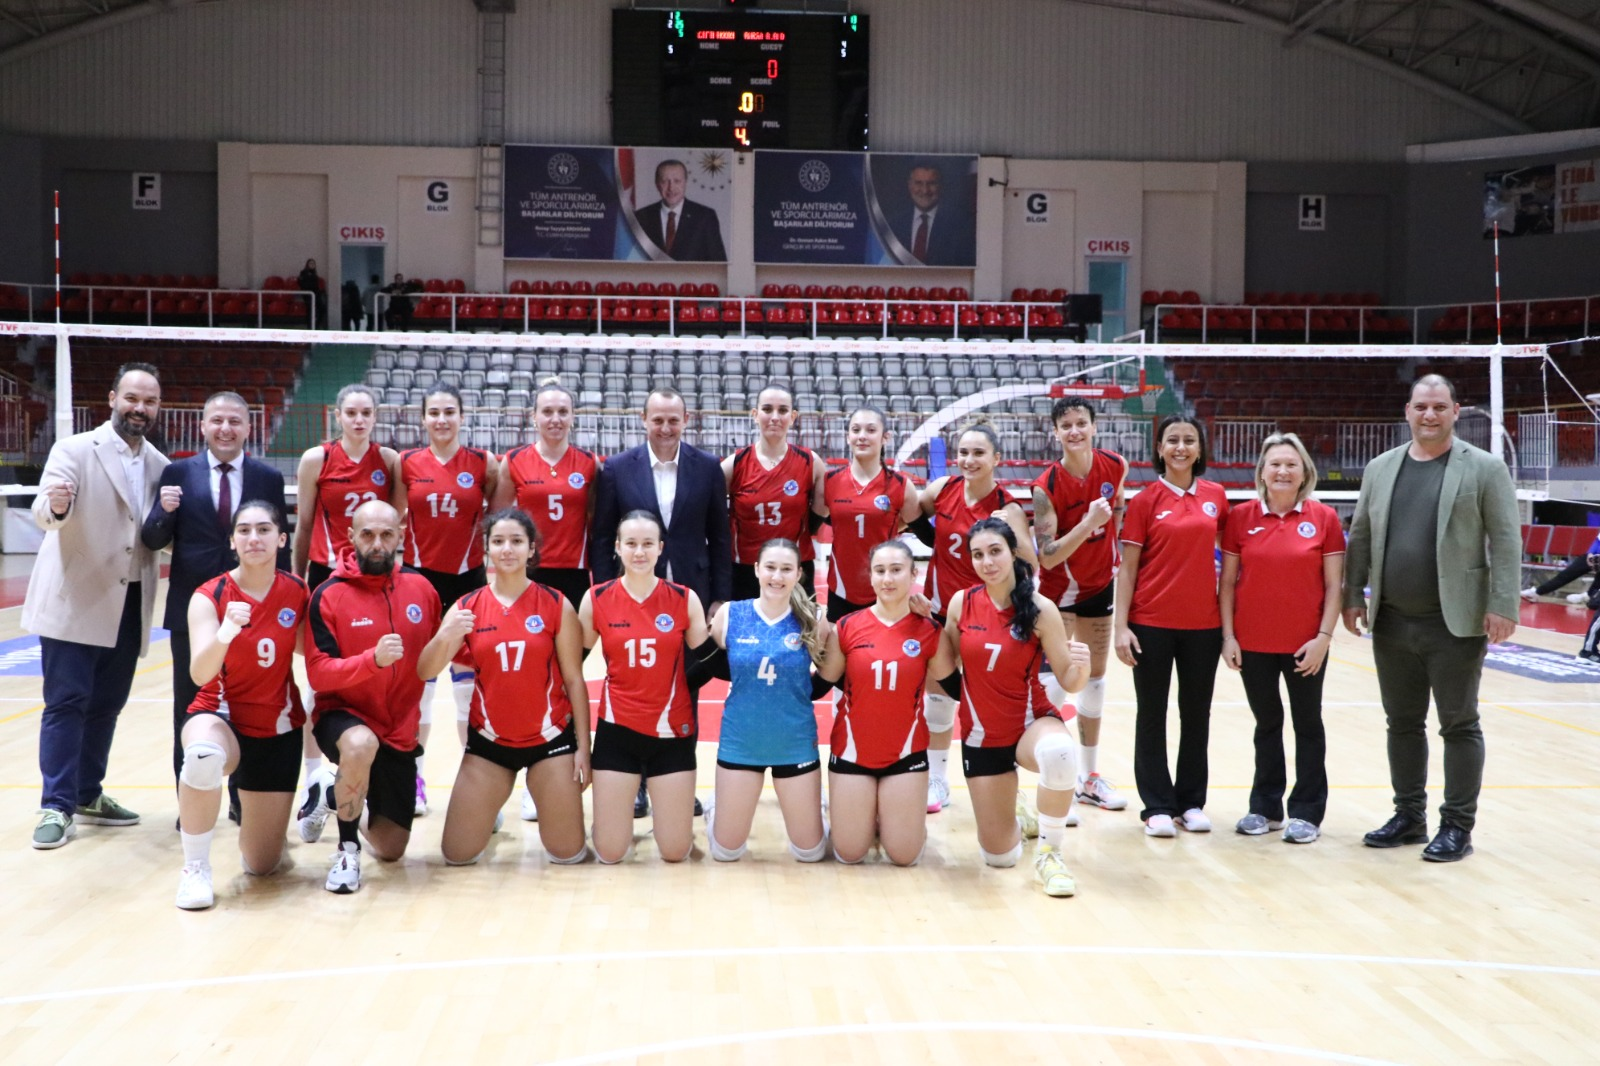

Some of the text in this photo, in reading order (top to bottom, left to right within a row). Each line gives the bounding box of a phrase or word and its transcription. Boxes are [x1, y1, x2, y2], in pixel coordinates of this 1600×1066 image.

[768, 60, 778, 78] 0
[139, 176, 154, 197] F
[427, 181, 449, 202] G
[530, 191, 597, 202] TÜM ANTRENÖR
[532, 201, 606, 210] SPORCULARIMIZA
[780, 201, 848, 211] TÜM ANTRENÖR
[1027, 193, 1047, 214] G
[1303, 198, 1321, 218] H
[522, 210, 562, 219] BAŞARILAR
[774, 220, 813, 229] BAŞARILAR
[784, 210, 857, 220] SPORCULARIMIZA
[340, 226, 385, 242] ÇIKIŞ
[1088, 240, 1130, 254] ÇIKIŞ
[426, 493, 458, 518] 14
[548, 494, 564, 520] 5
[755, 502, 782, 526] 13
[855, 514, 865, 538] 1
[949, 533, 962, 559] 2
[258, 638, 276, 668] 9
[495, 641, 525, 672] 17
[624, 638, 656, 668] 15
[984, 643, 1002, 671] 7
[757, 657, 777, 686] 4
[871, 660, 897, 691] 11
